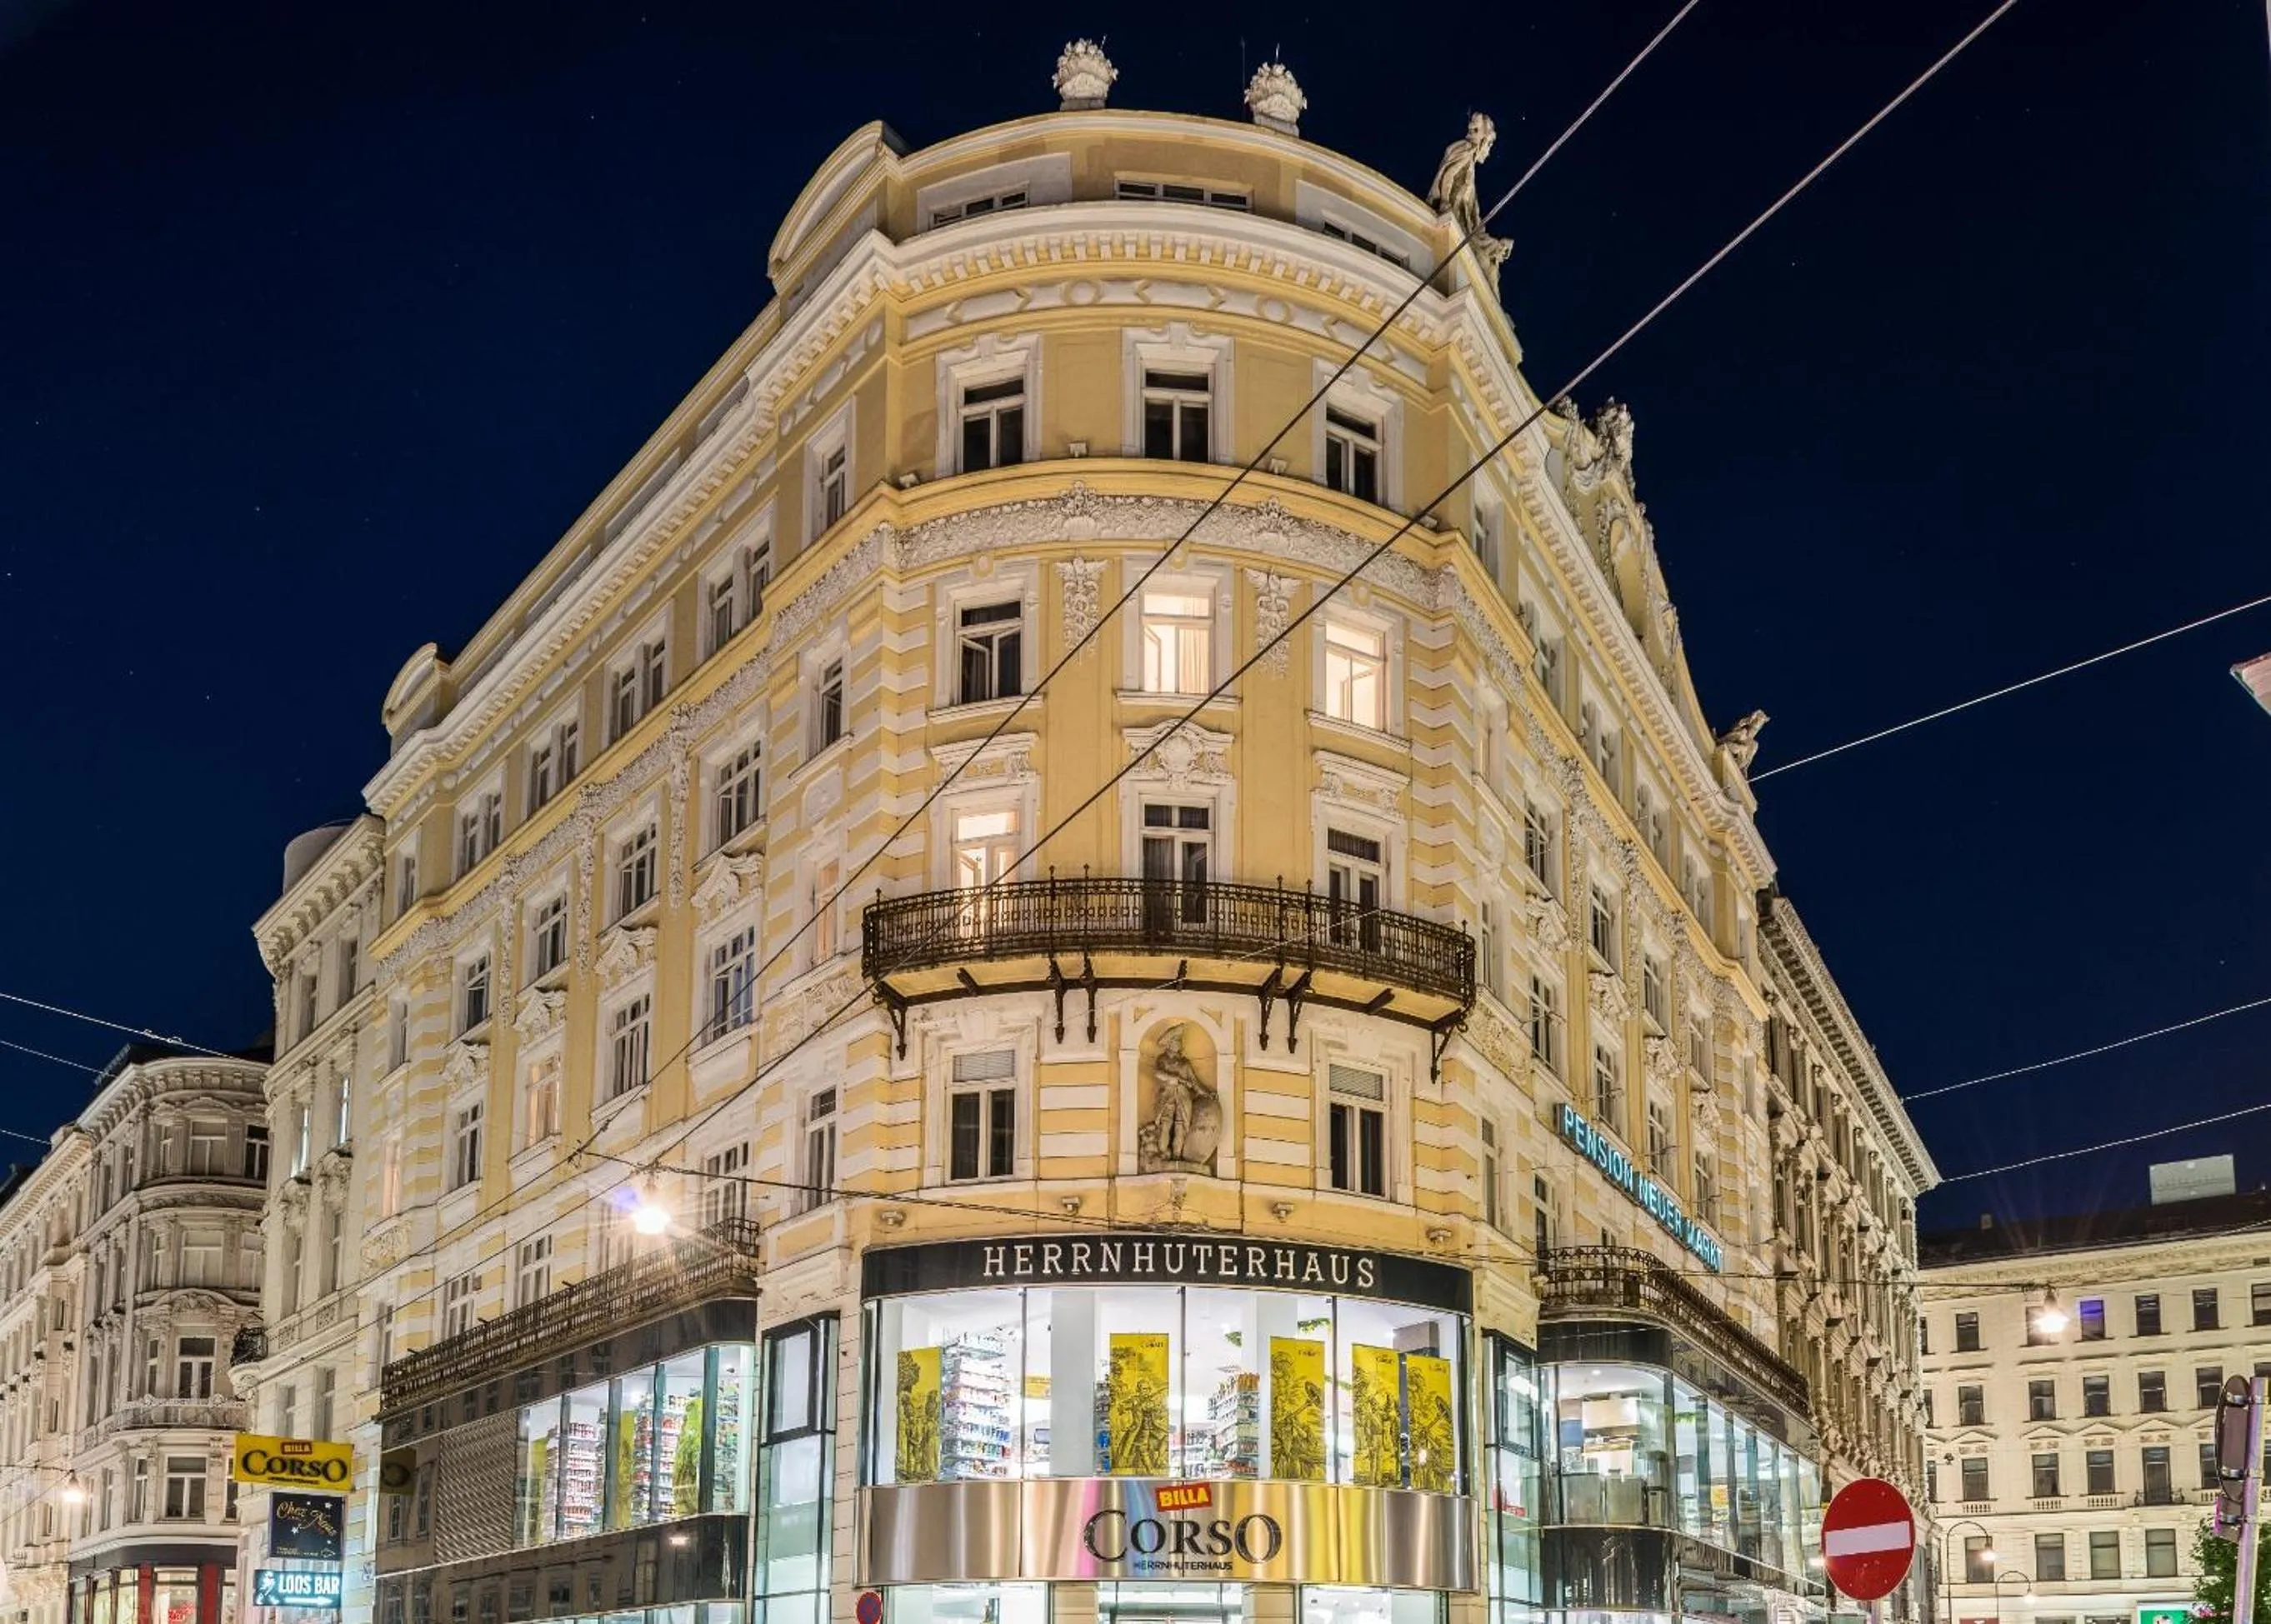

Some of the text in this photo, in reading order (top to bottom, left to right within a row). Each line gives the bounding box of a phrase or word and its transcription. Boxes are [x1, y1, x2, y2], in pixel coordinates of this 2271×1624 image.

[1563, 1105, 1723, 1271] PENSION NEUER MARKT
[983, 1242, 1375, 1288] HERRNHUTERHAUS
[242, 1449, 348, 1483] CORSO
[276, 1501, 308, 1519] Chez
[1158, 1487, 1208, 1507] BILLA
[1083, 1509, 1283, 1564] CORSO
[1133, 1561, 1233, 1571] HERRNHUTERHAUS
[278, 1572, 340, 1595] LOOS BAR
